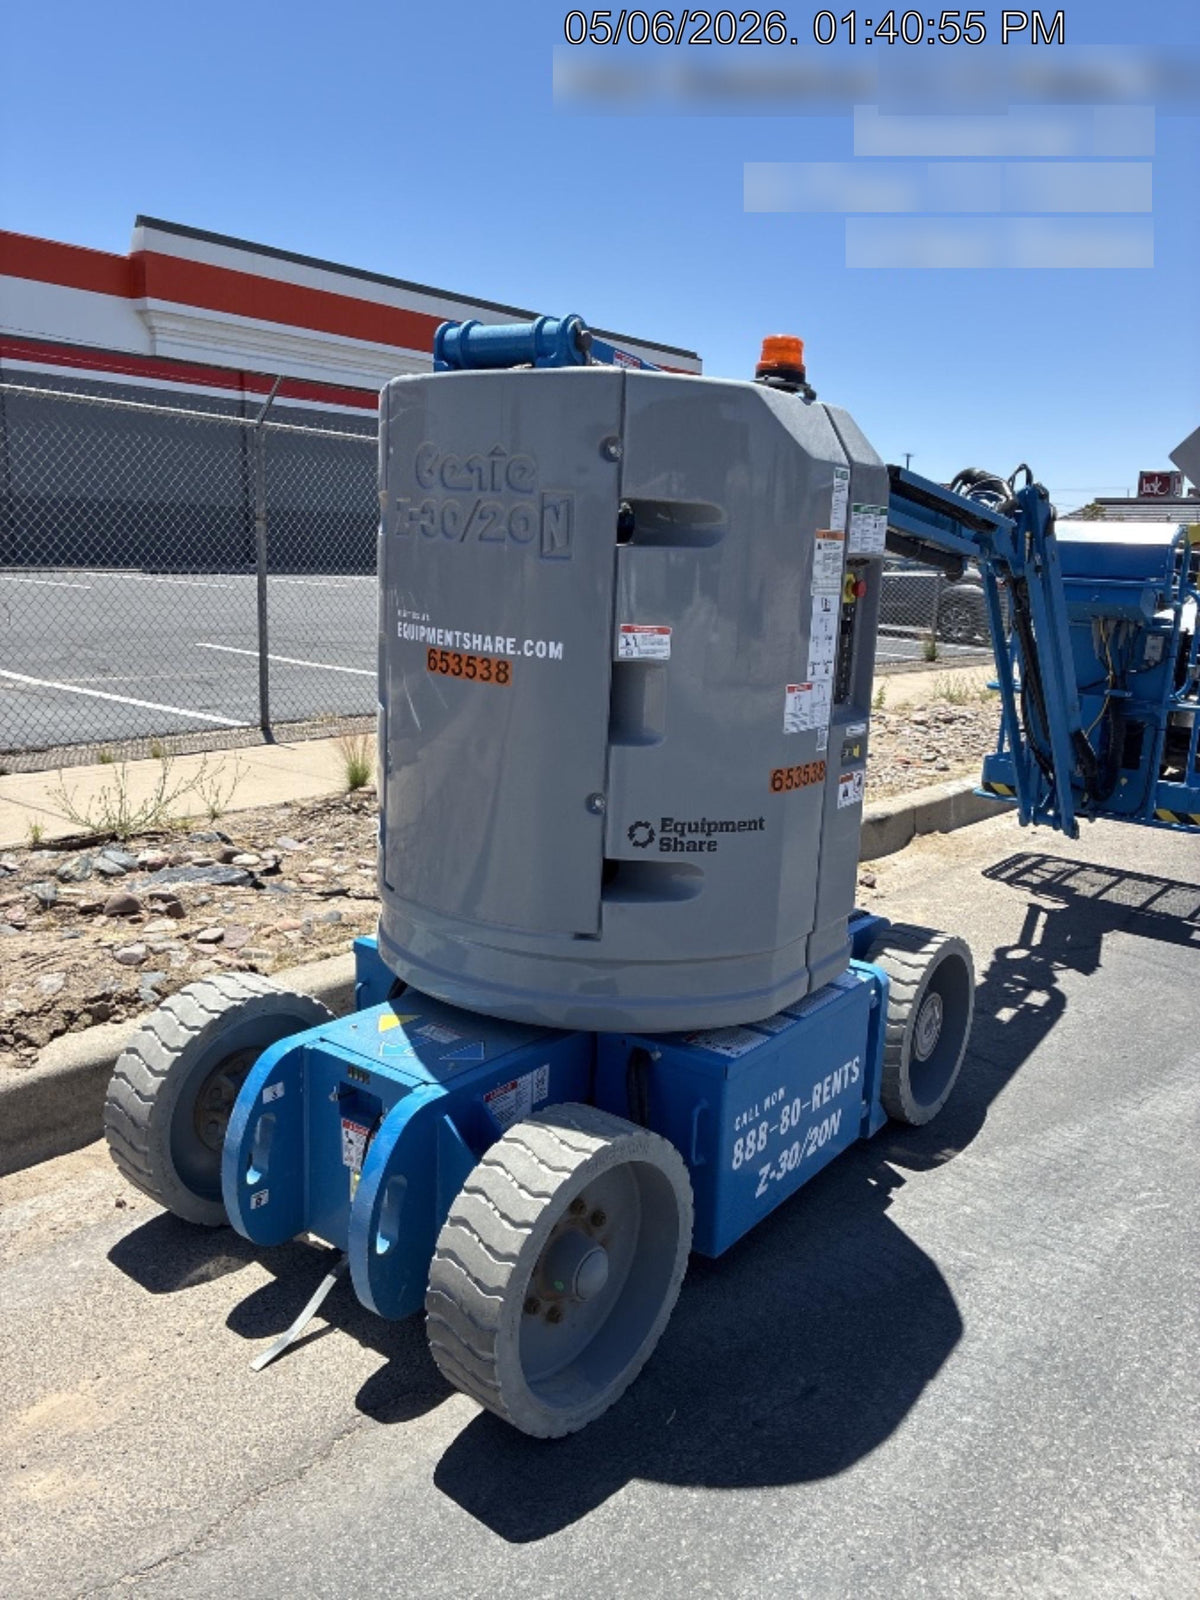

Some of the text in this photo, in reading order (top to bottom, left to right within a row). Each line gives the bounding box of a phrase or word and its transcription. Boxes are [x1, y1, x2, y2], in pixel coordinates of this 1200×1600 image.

[397, 621, 564, 660] EQUIPMENTSHARE.COM
[427, 648, 510, 684] 653538
[771, 761, 826, 792] 653538
[660, 816, 765, 837] Equipment
[659, 837, 718, 853] Share
[732, 1055, 860, 1171] 888-80-RENTS
[734, 1104, 760, 1131] CALL
[755, 1108, 842, 1199] Z-30/20N
